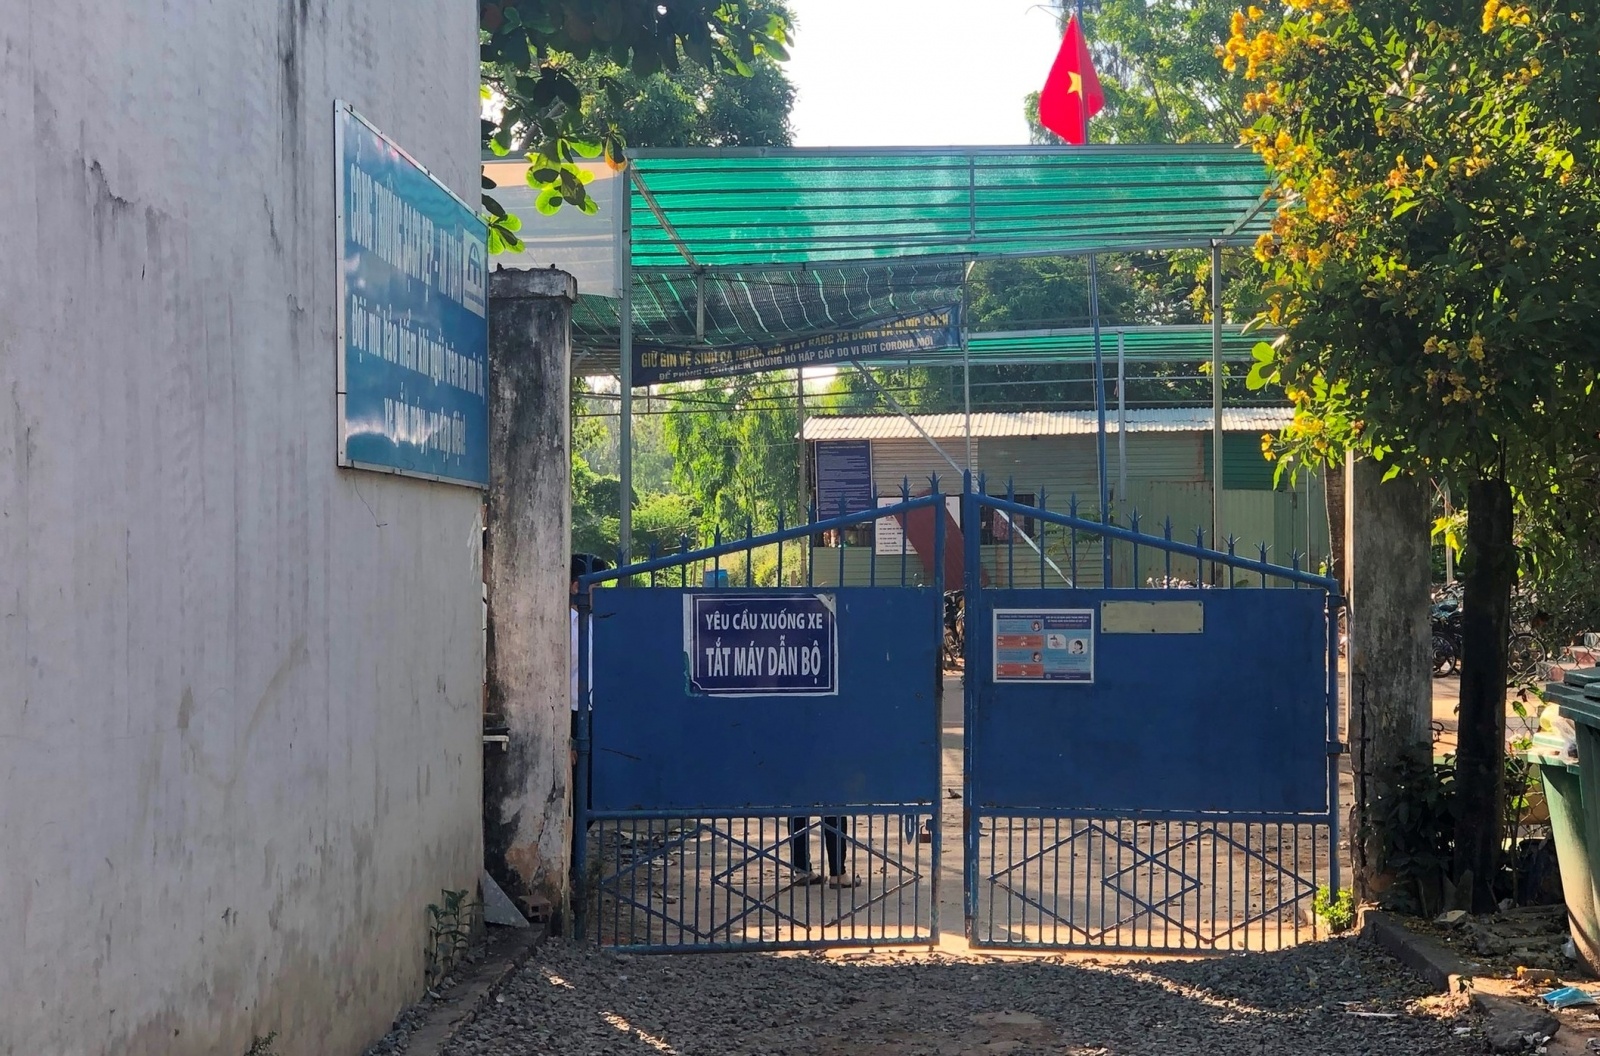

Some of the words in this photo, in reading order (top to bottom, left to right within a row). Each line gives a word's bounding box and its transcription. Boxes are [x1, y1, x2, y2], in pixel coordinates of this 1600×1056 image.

[351, 293, 366, 362] Đội
[368, 300, 380, 357] mũ
[383, 302, 397, 364] bảo
[399, 304, 416, 371] hiểm
[418, 326, 428, 376] khi
[445, 340, 458, 387] trên
[460, 355, 466, 390] xe
[641, 350, 658, 368] GIỮ
[679, 350, 692, 369] VỆ
[694, 352, 718, 366] SINH
[798, 350, 816, 362] HẤP
[818, 346, 835, 360] CẤP
[837, 347, 848, 357] DO
[851, 346, 860, 355] VI
[862, 342, 878, 354] RÚT
[880, 339, 915, 352] CORONA
[384, 397, 393, 438] xe
[429, 411, 438, 449] xe
[706, 611, 729, 630] YÊU
[733, 609, 757, 629] CẦU
[761, 608, 804, 629] XUỐNG
[808, 613, 823, 629] XE
[706, 637, 730, 676] TẮT
[734, 641, 764, 676] MÁY
[768, 635, 797, 675] DẪN
[802, 640, 821, 684] BỘ
